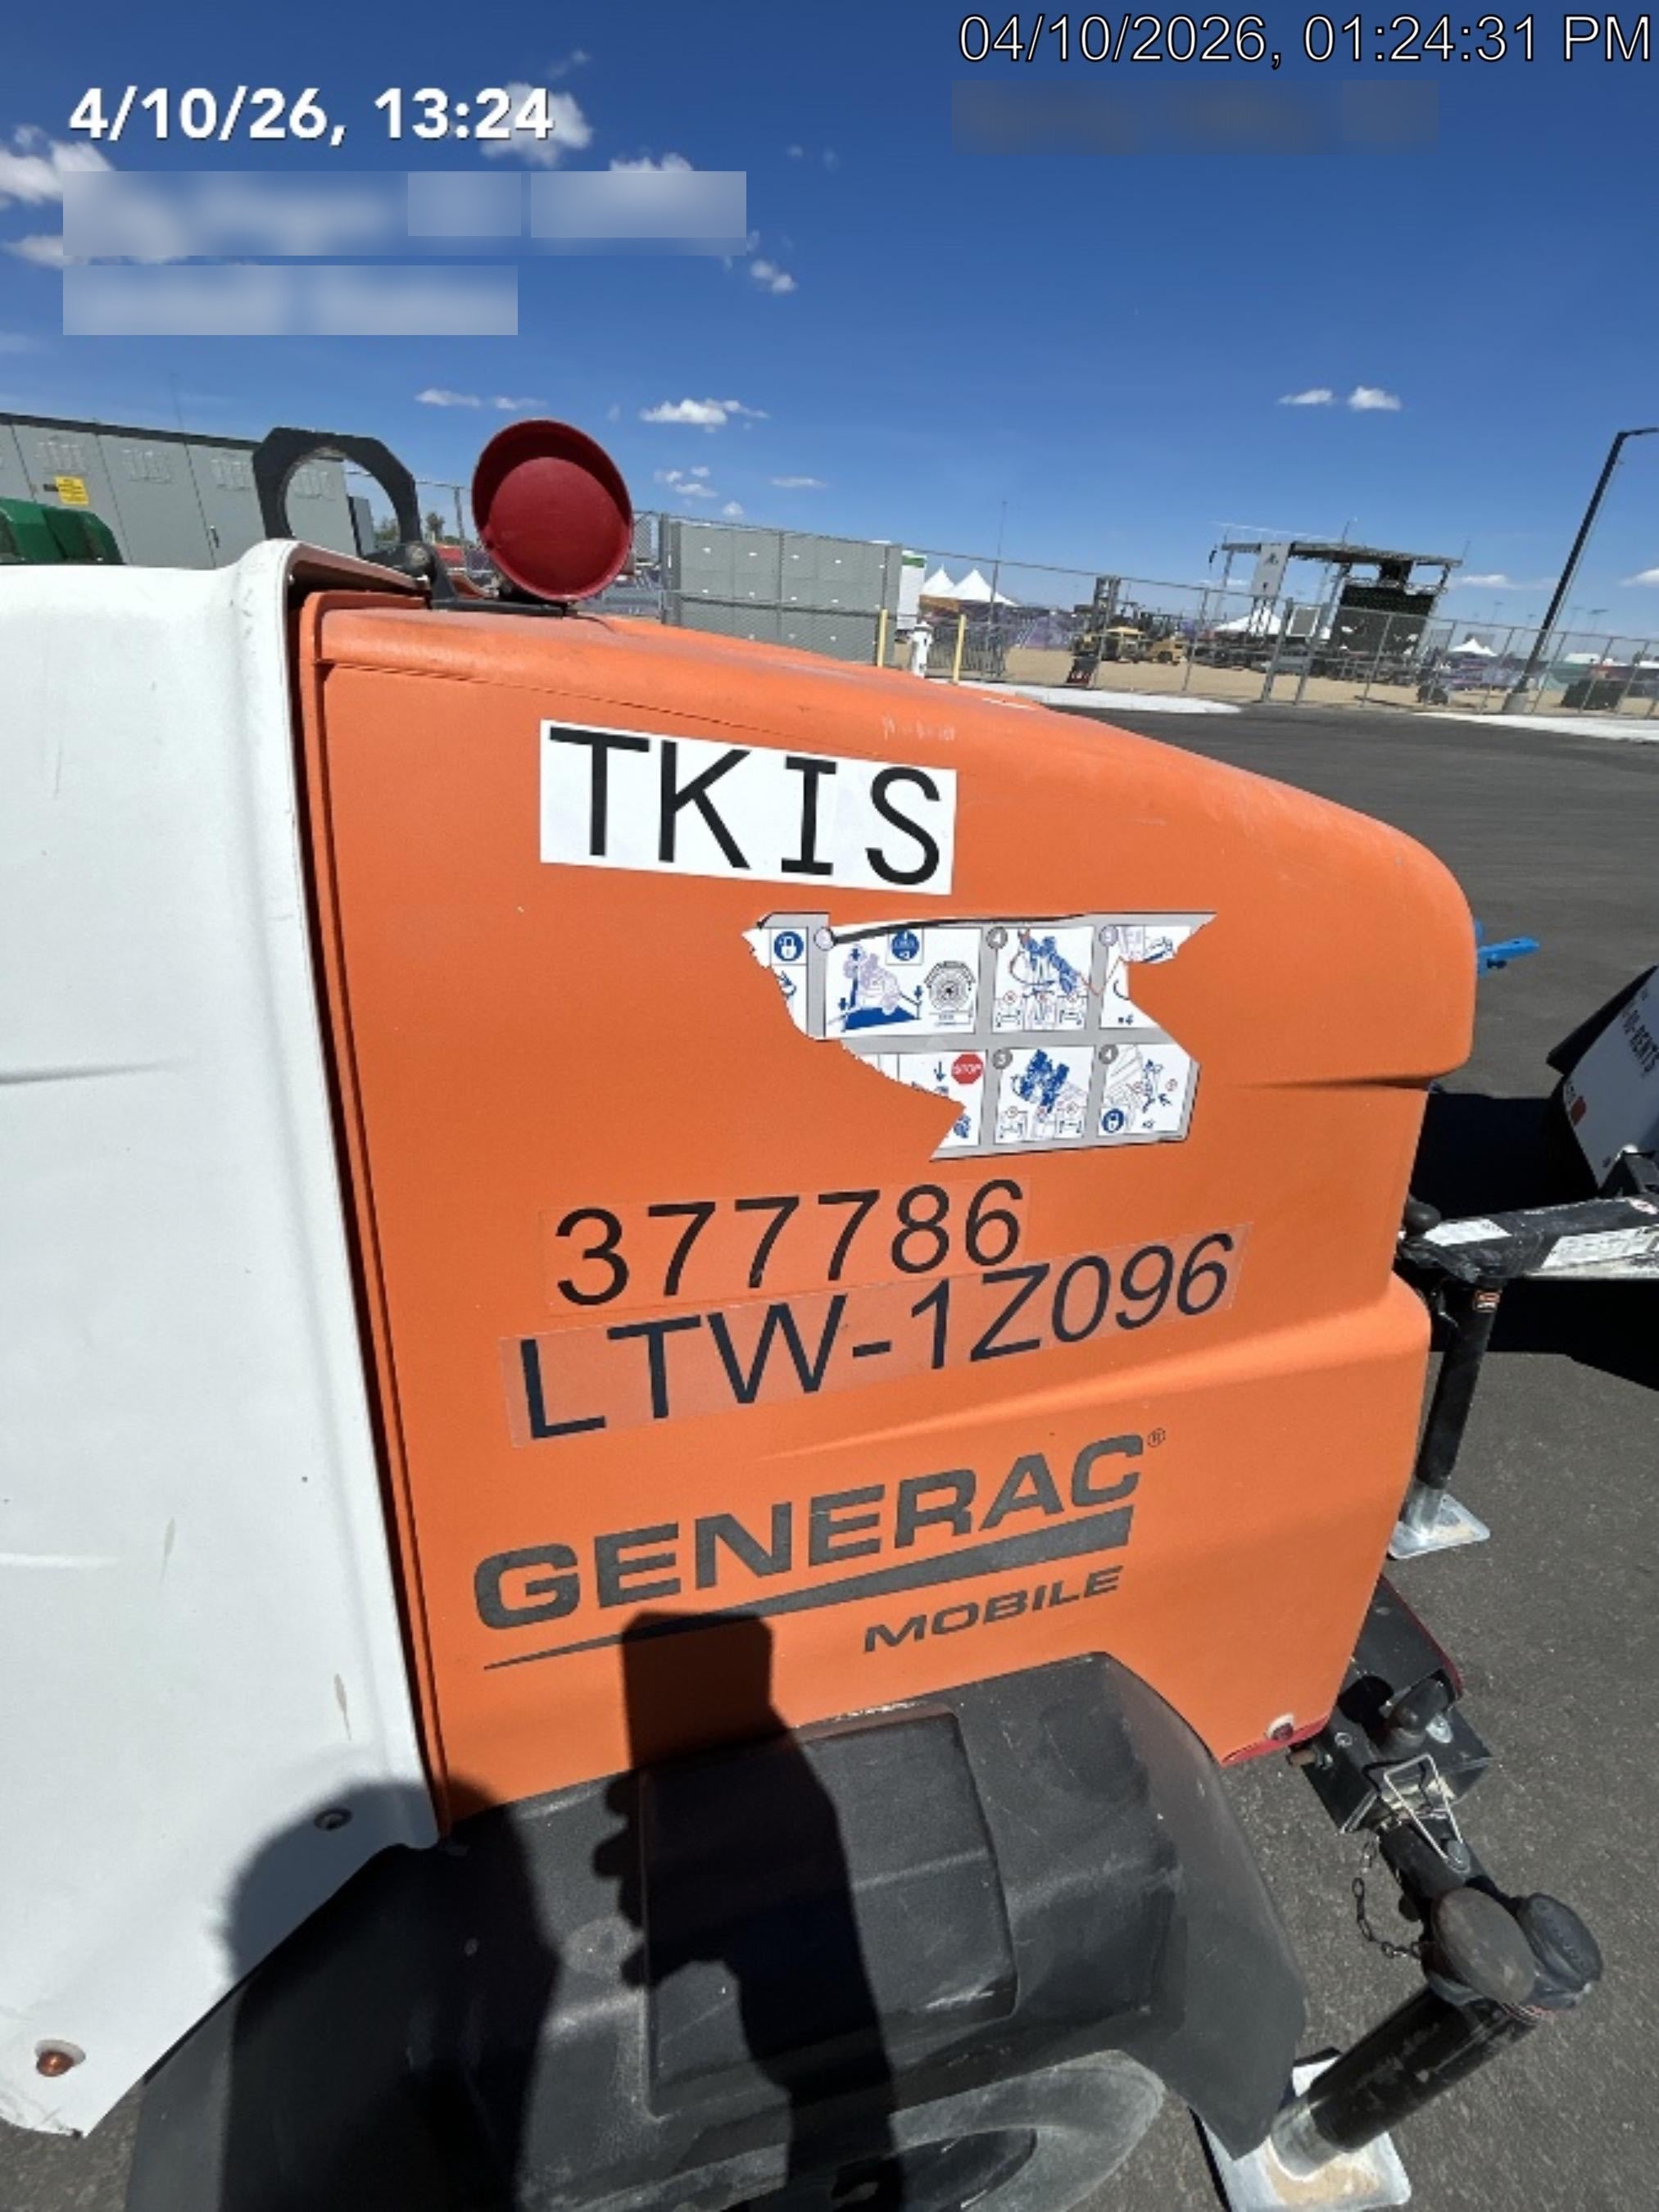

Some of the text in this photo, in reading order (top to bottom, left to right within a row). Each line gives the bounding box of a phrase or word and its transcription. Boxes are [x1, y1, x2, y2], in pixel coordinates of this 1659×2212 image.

[550, 726, 940, 885] TKIS
[555, 1179, 1023, 1306] 377786
[519, 1232, 1234, 1439] LTW-1Z096
[474, 1435, 1144, 1630] GENERAC
[864, 1565, 1123, 1653] MOBILE
